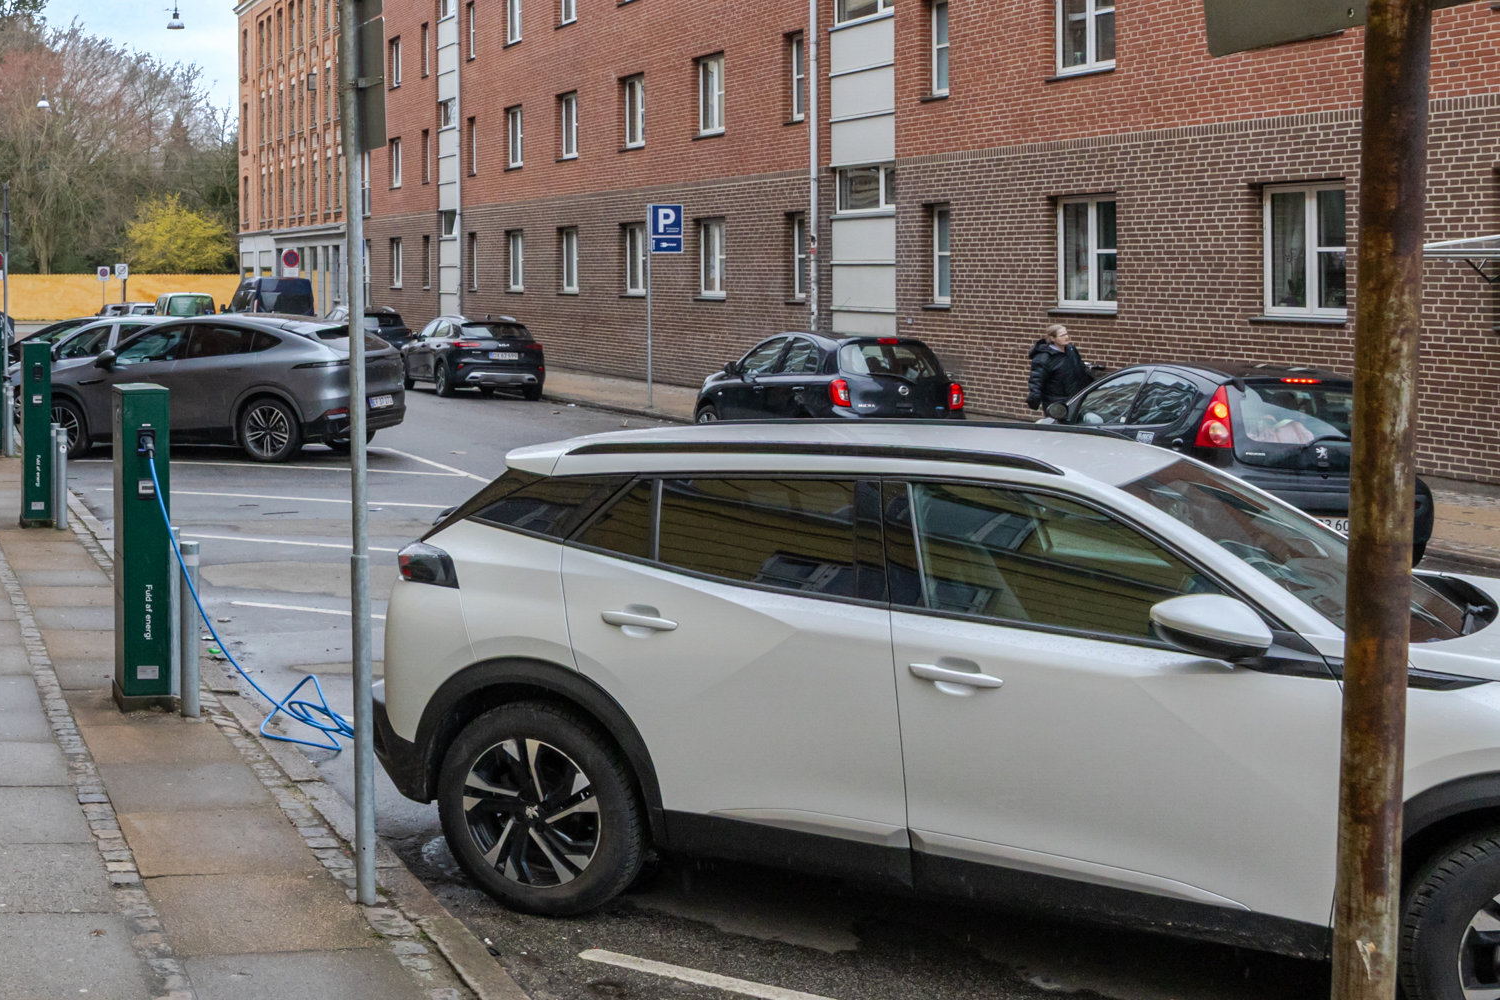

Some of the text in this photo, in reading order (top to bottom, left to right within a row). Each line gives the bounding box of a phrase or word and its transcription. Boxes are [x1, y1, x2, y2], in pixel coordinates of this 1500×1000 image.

[658, 208, 676, 233] P
[143, 584, 153, 640] Fuld af energi
